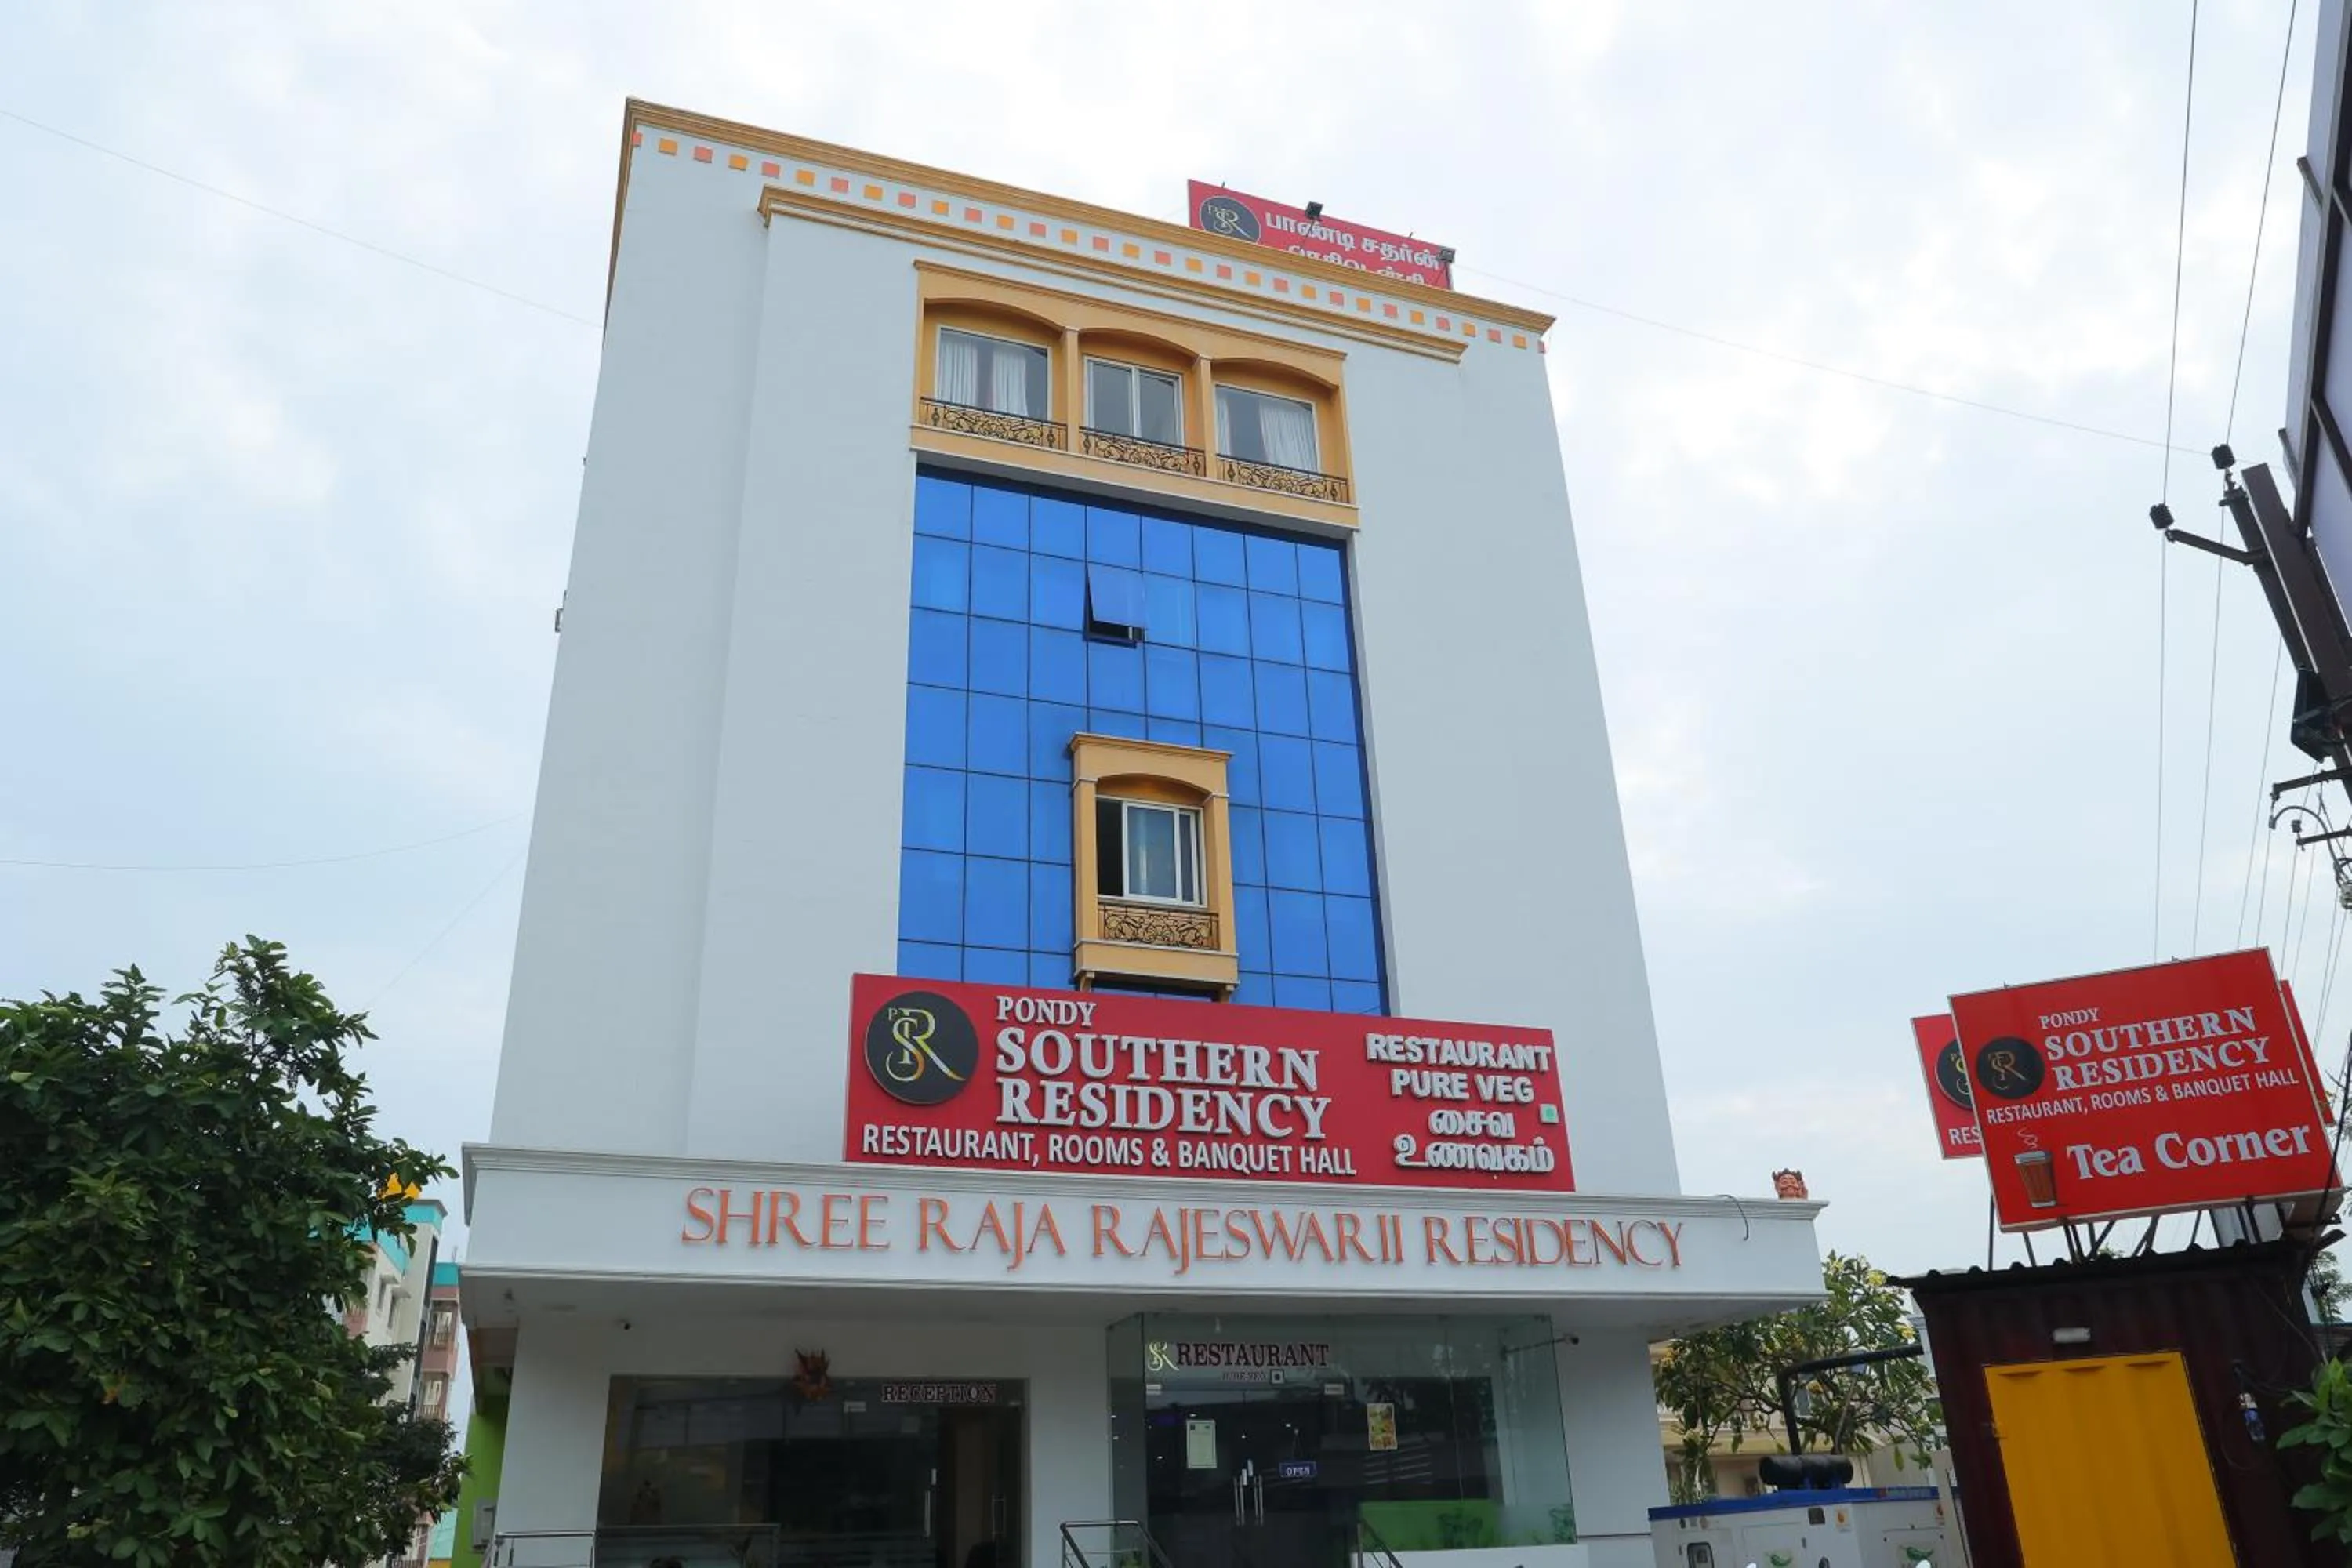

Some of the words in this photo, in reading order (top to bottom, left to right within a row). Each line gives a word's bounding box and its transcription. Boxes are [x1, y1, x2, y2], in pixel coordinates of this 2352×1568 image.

[1265, 212, 1356, 249] பாண்டி
[996, 995, 1097, 1027] PONDY
[2038, 1007, 2101, 1029] PONDY
[1366, 1033, 1552, 1072] RESTAURANT
[2044, 1006, 2257, 1062] SOUTHERN
[996, 1026, 1319, 1092] SOUTHERN
[2052, 1036, 2270, 1091] RESIDENCY
[1391, 1069, 1470, 1100] PURE
[1475, 1073, 1534, 1104] VEG
[1986, 1096, 2088, 1125] RESTAURANT,
[2091, 1087, 2152, 1110] ROOMS
[2155, 1087, 2169, 1102] &
[2173, 1074, 2251, 1098] BANQUET
[2256, 1068, 2299, 1088] HALL
[996, 1076, 1331, 1140] RESIDENCY
[1428, 1109, 1515, 1138] சைவ
[862, 1123, 1040, 1167] RESTAURANT,
[1048, 1134, 1144, 1167] ROOMS
[1150, 1137, 1171, 1167] &
[1178, 1141, 1294, 1174] BANQUET
[1299, 1145, 1357, 1175] HALL
[1393, 1133, 1555, 1172] உணவகம்
[2067, 1144, 2146, 1180] Tea
[2154, 1124, 2310, 1170] Corner
[681, 1187, 891, 1250] SHREE
[918, 1196, 1066, 1272] RAJA
[1091, 1204, 1404, 1274] RAJESWARII
[1423, 1216, 1682, 1268] RESIDENCY
[1176, 1342, 1330, 1370] RESTAURANT
[881, 1384, 997, 1403] RECEPTION
